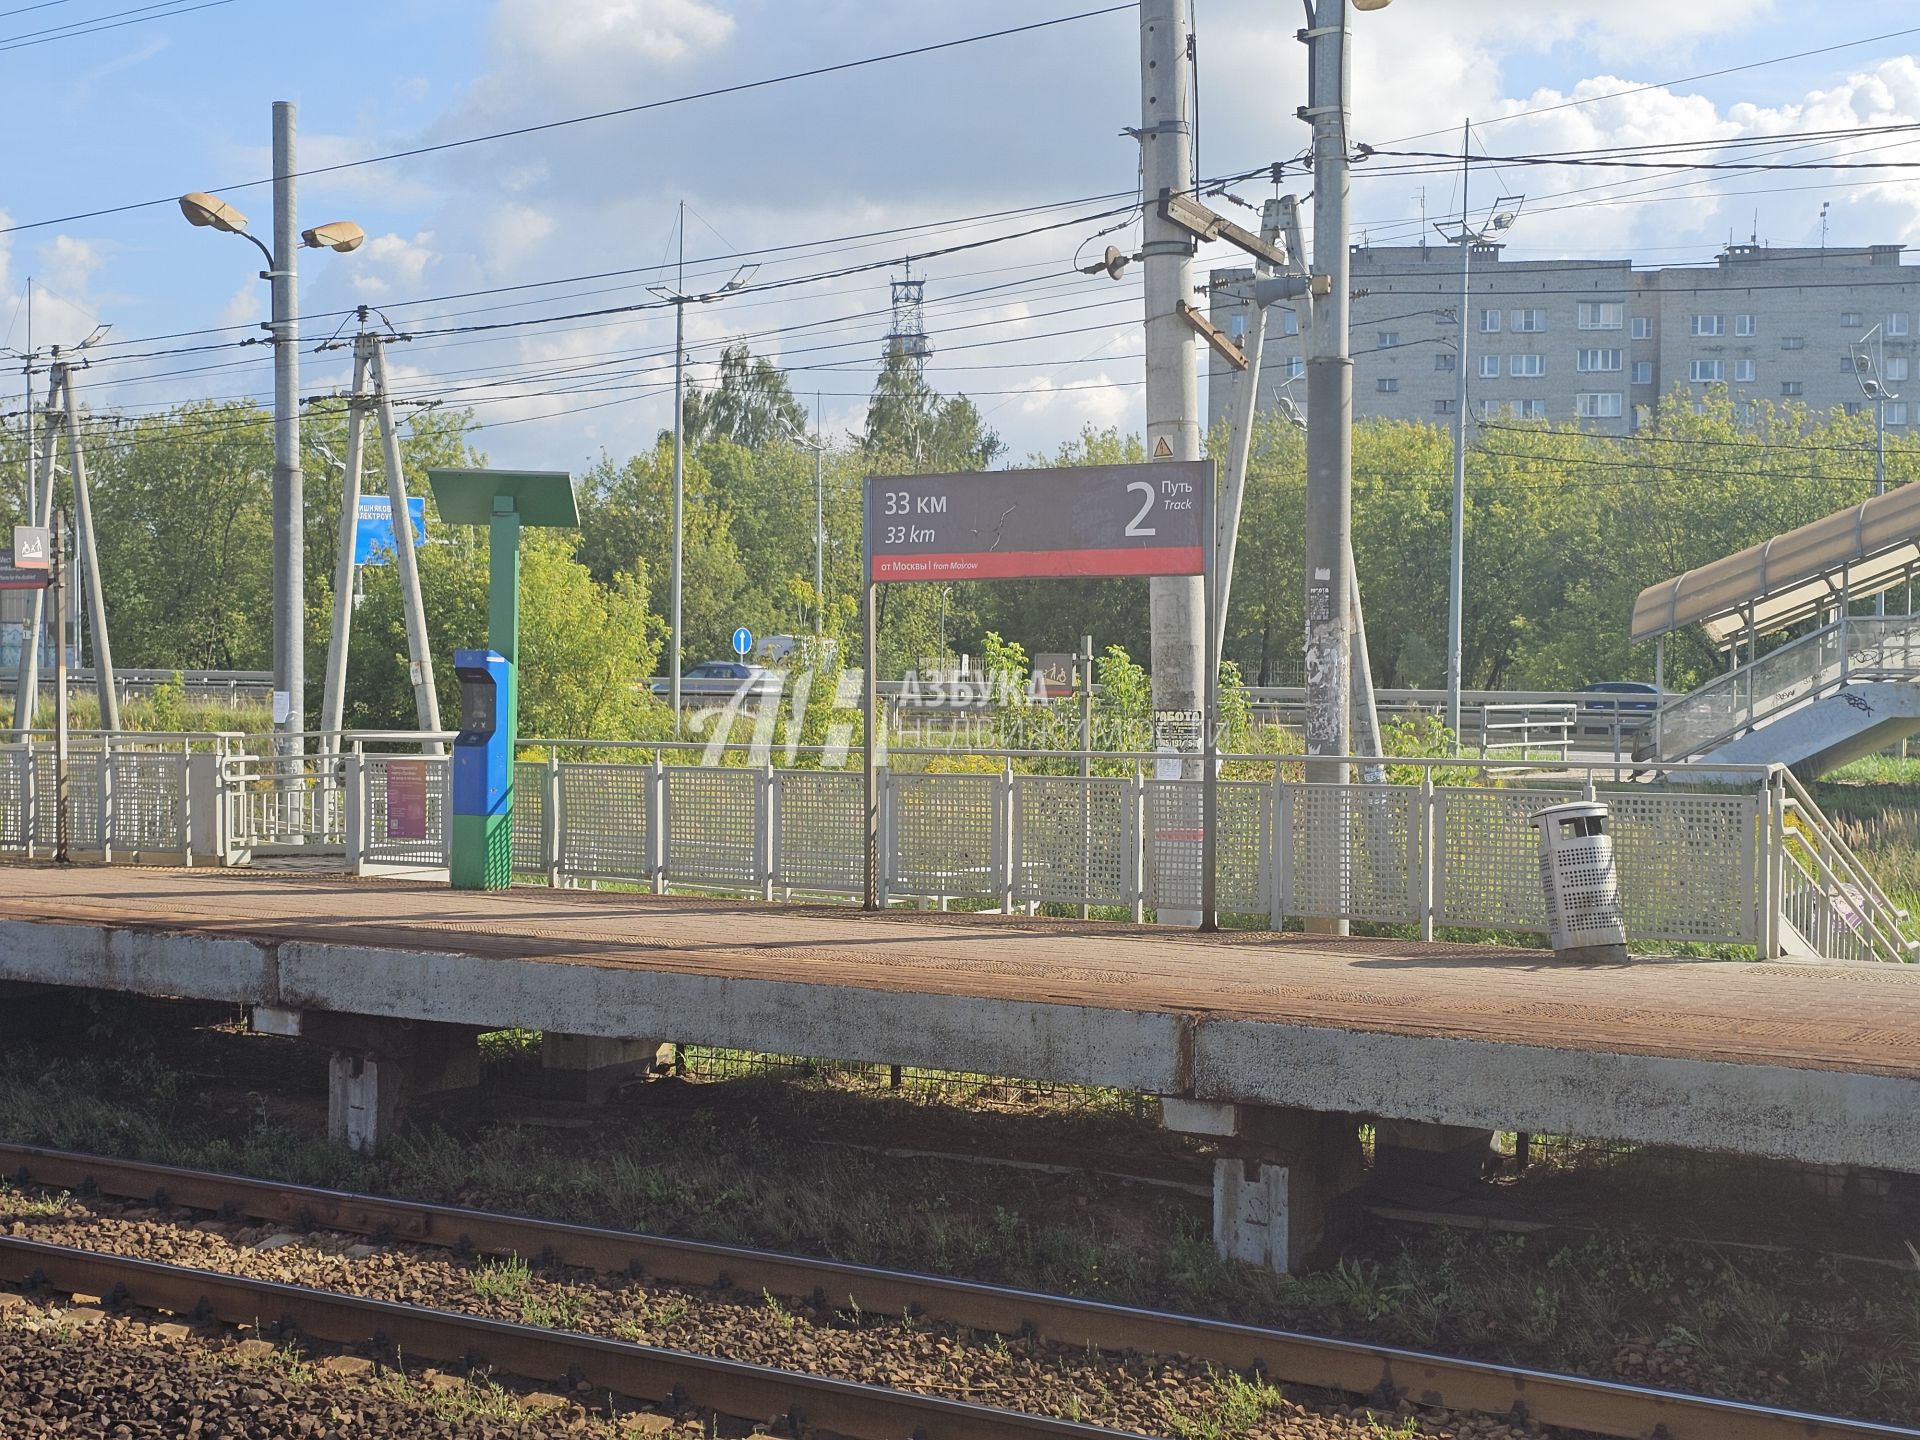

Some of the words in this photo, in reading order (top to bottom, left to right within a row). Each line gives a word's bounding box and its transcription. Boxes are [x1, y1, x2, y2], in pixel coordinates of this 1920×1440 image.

[1161, 480, 1193, 497] Путь
[884, 491, 910, 515] 33
[917, 495, 947, 514] км
[1125, 481, 1156, 537] 2
[1164, 498, 1193, 510] Track
[885, 526, 906, 544] 33
[909, 524, 936, 543] km
[881, 563, 891, 571] от
[892, 561, 928, 571] Москвы
[933, 561, 949, 570] from
[949, 561, 978, 570] Moscow
[1155, 711, 1200, 722] РАБОТА
